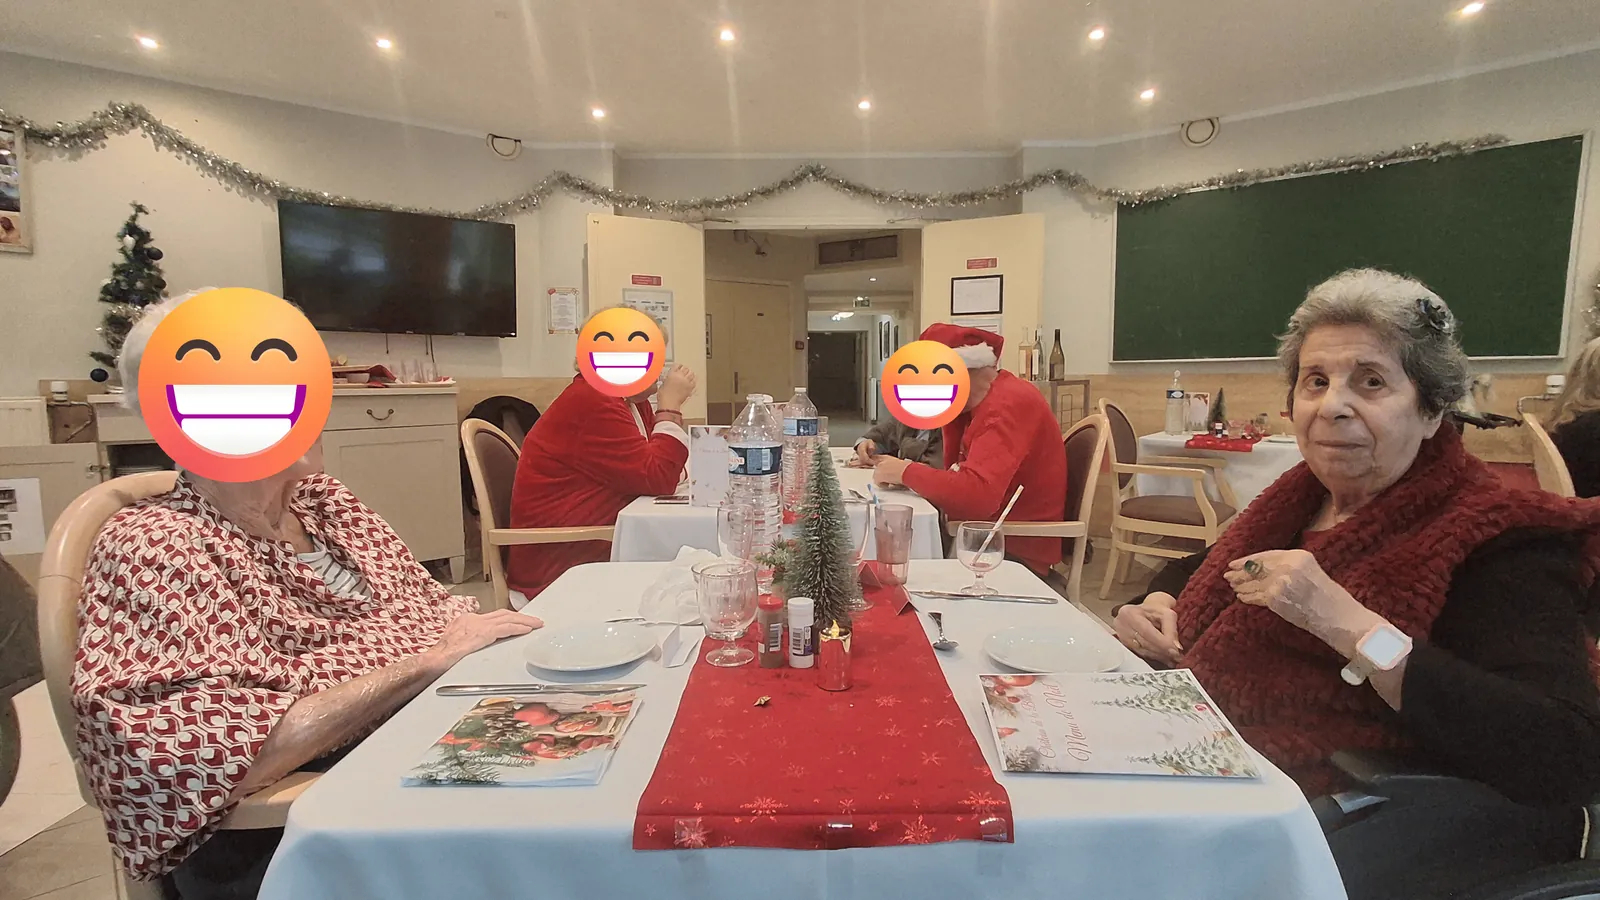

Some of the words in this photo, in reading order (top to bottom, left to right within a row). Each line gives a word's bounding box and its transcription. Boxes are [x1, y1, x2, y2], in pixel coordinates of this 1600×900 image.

[1040, 680, 1067, 708] Noël
[1056, 710, 1075, 720] de
[1065, 722, 1092, 761] Menu
